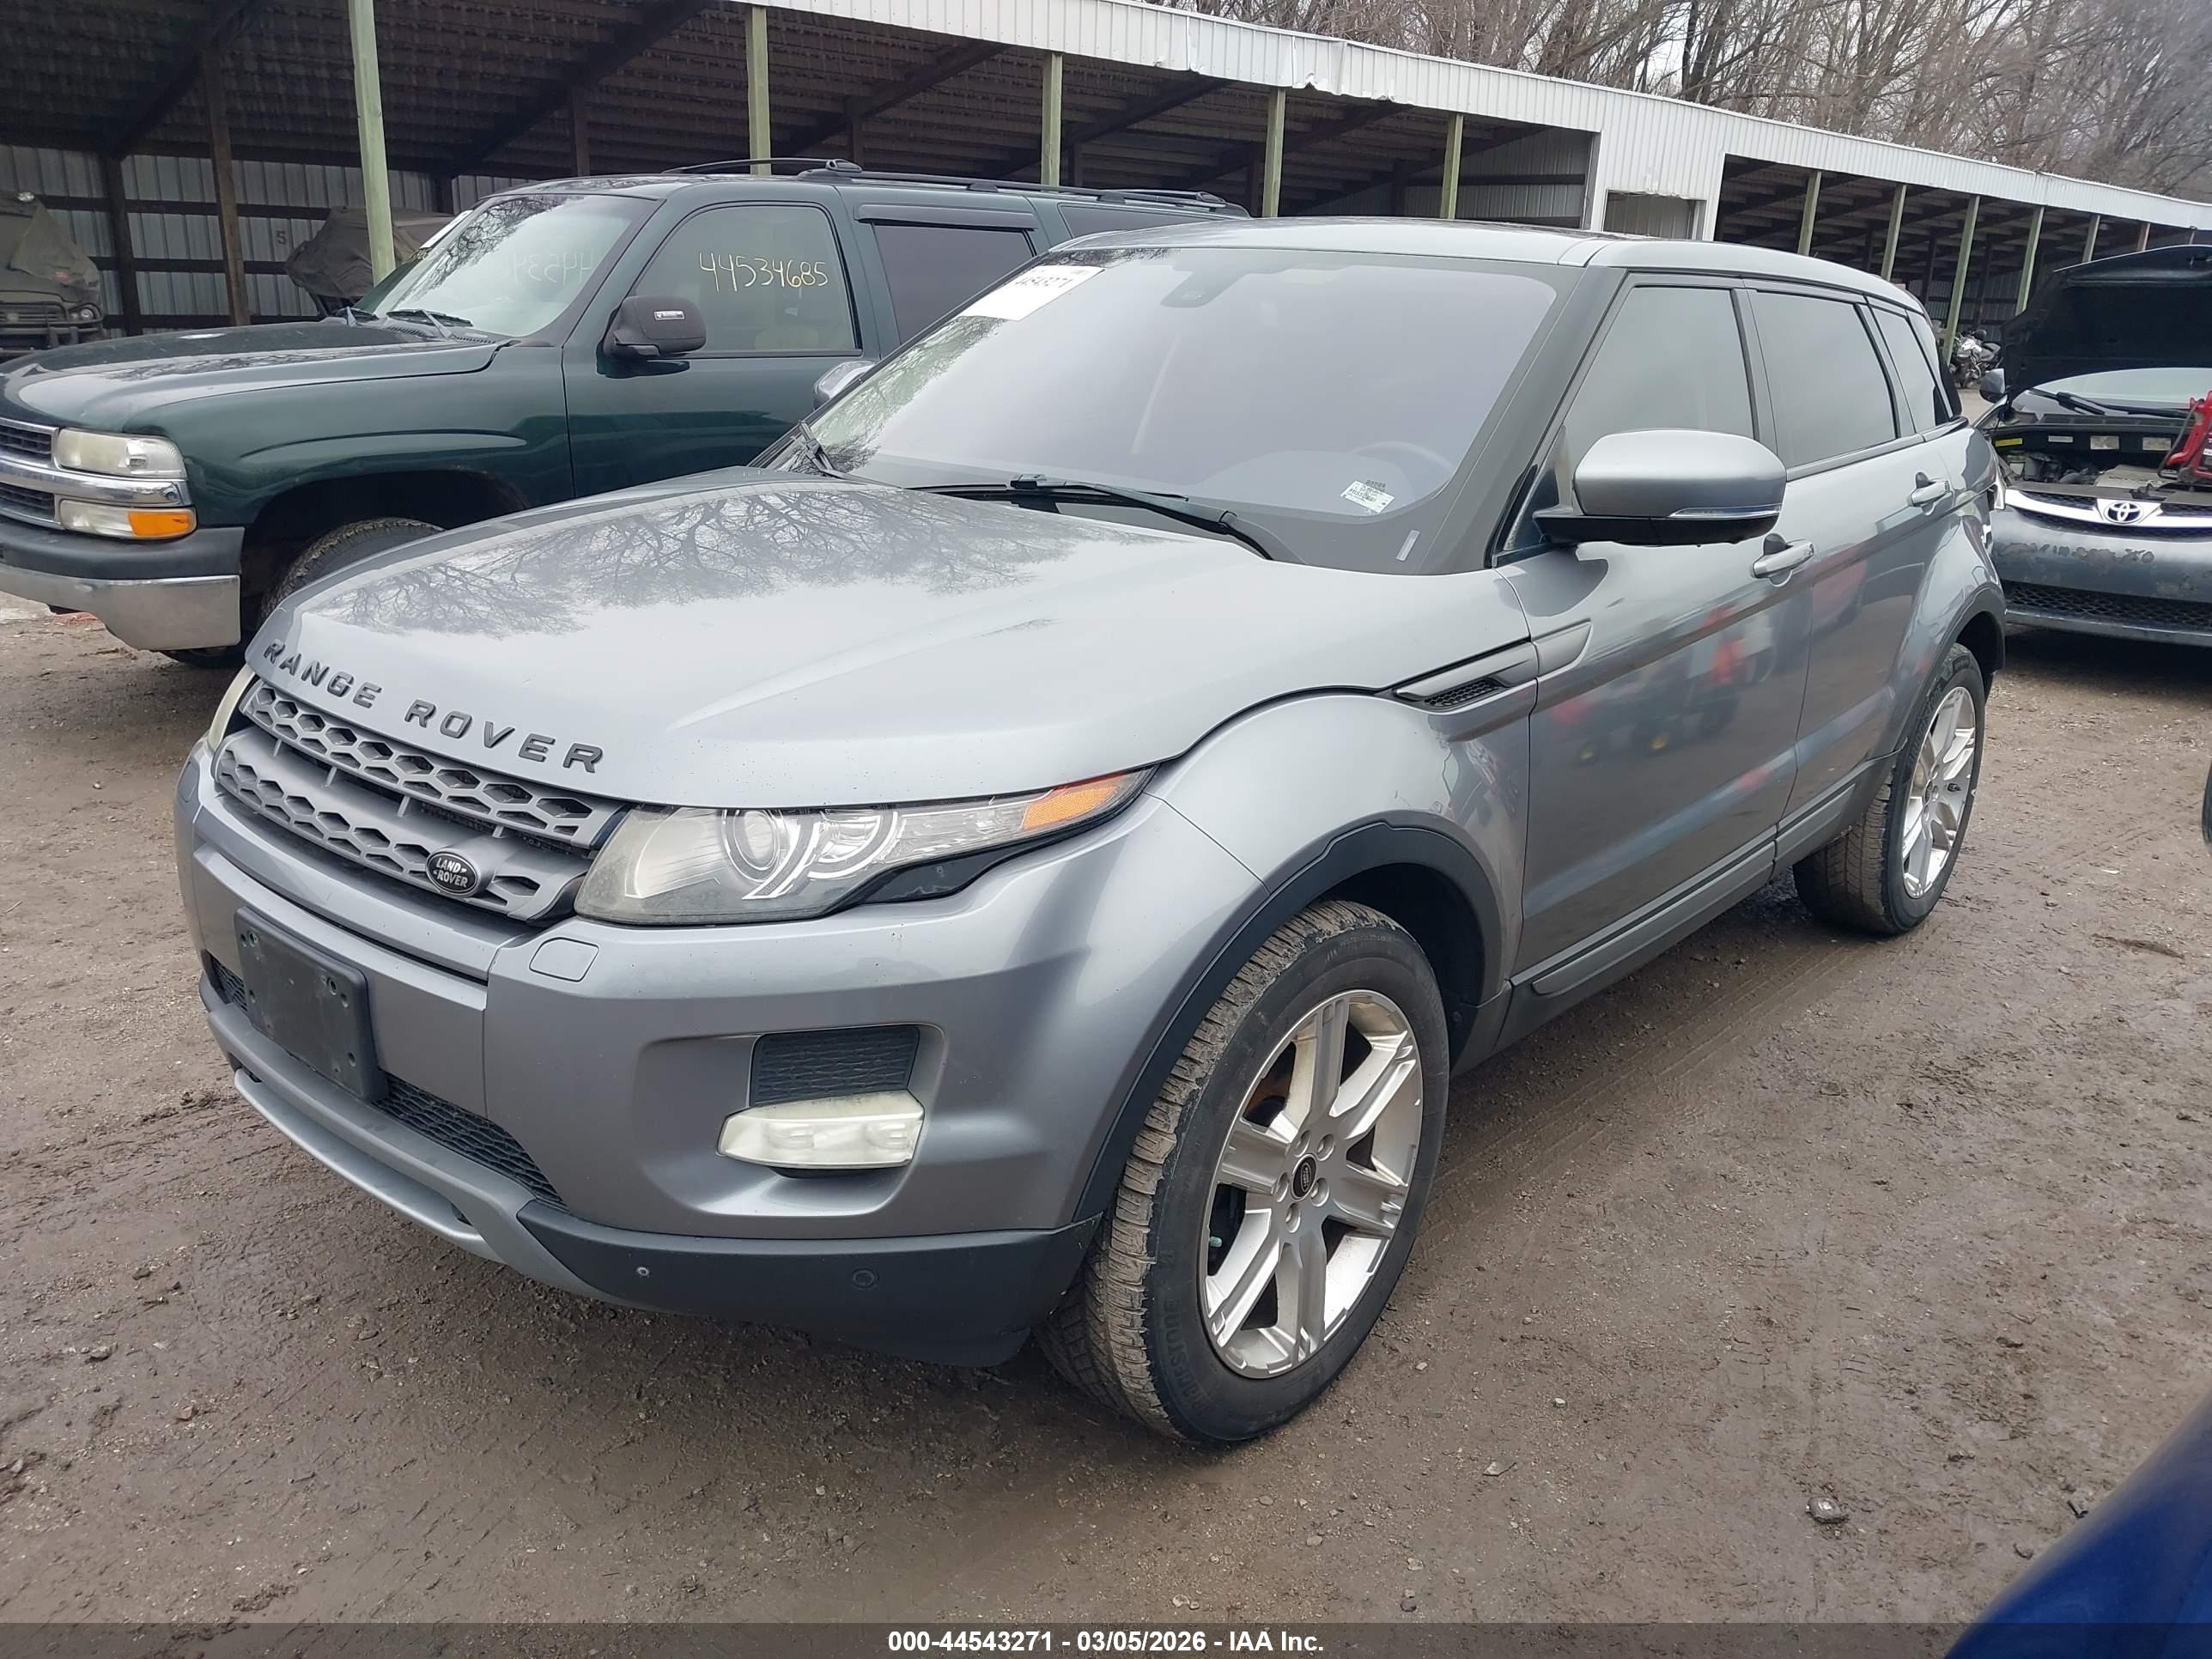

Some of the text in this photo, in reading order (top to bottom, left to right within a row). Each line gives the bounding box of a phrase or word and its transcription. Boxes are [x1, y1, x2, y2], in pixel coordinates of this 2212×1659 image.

[276, 230, 287, 246] 5
[699, 252, 829, 293] 44534685
[262, 638, 604, 775] RANGE ROVER
[436, 857, 462, 873] LAND
[436, 869, 469, 888] ROVER
